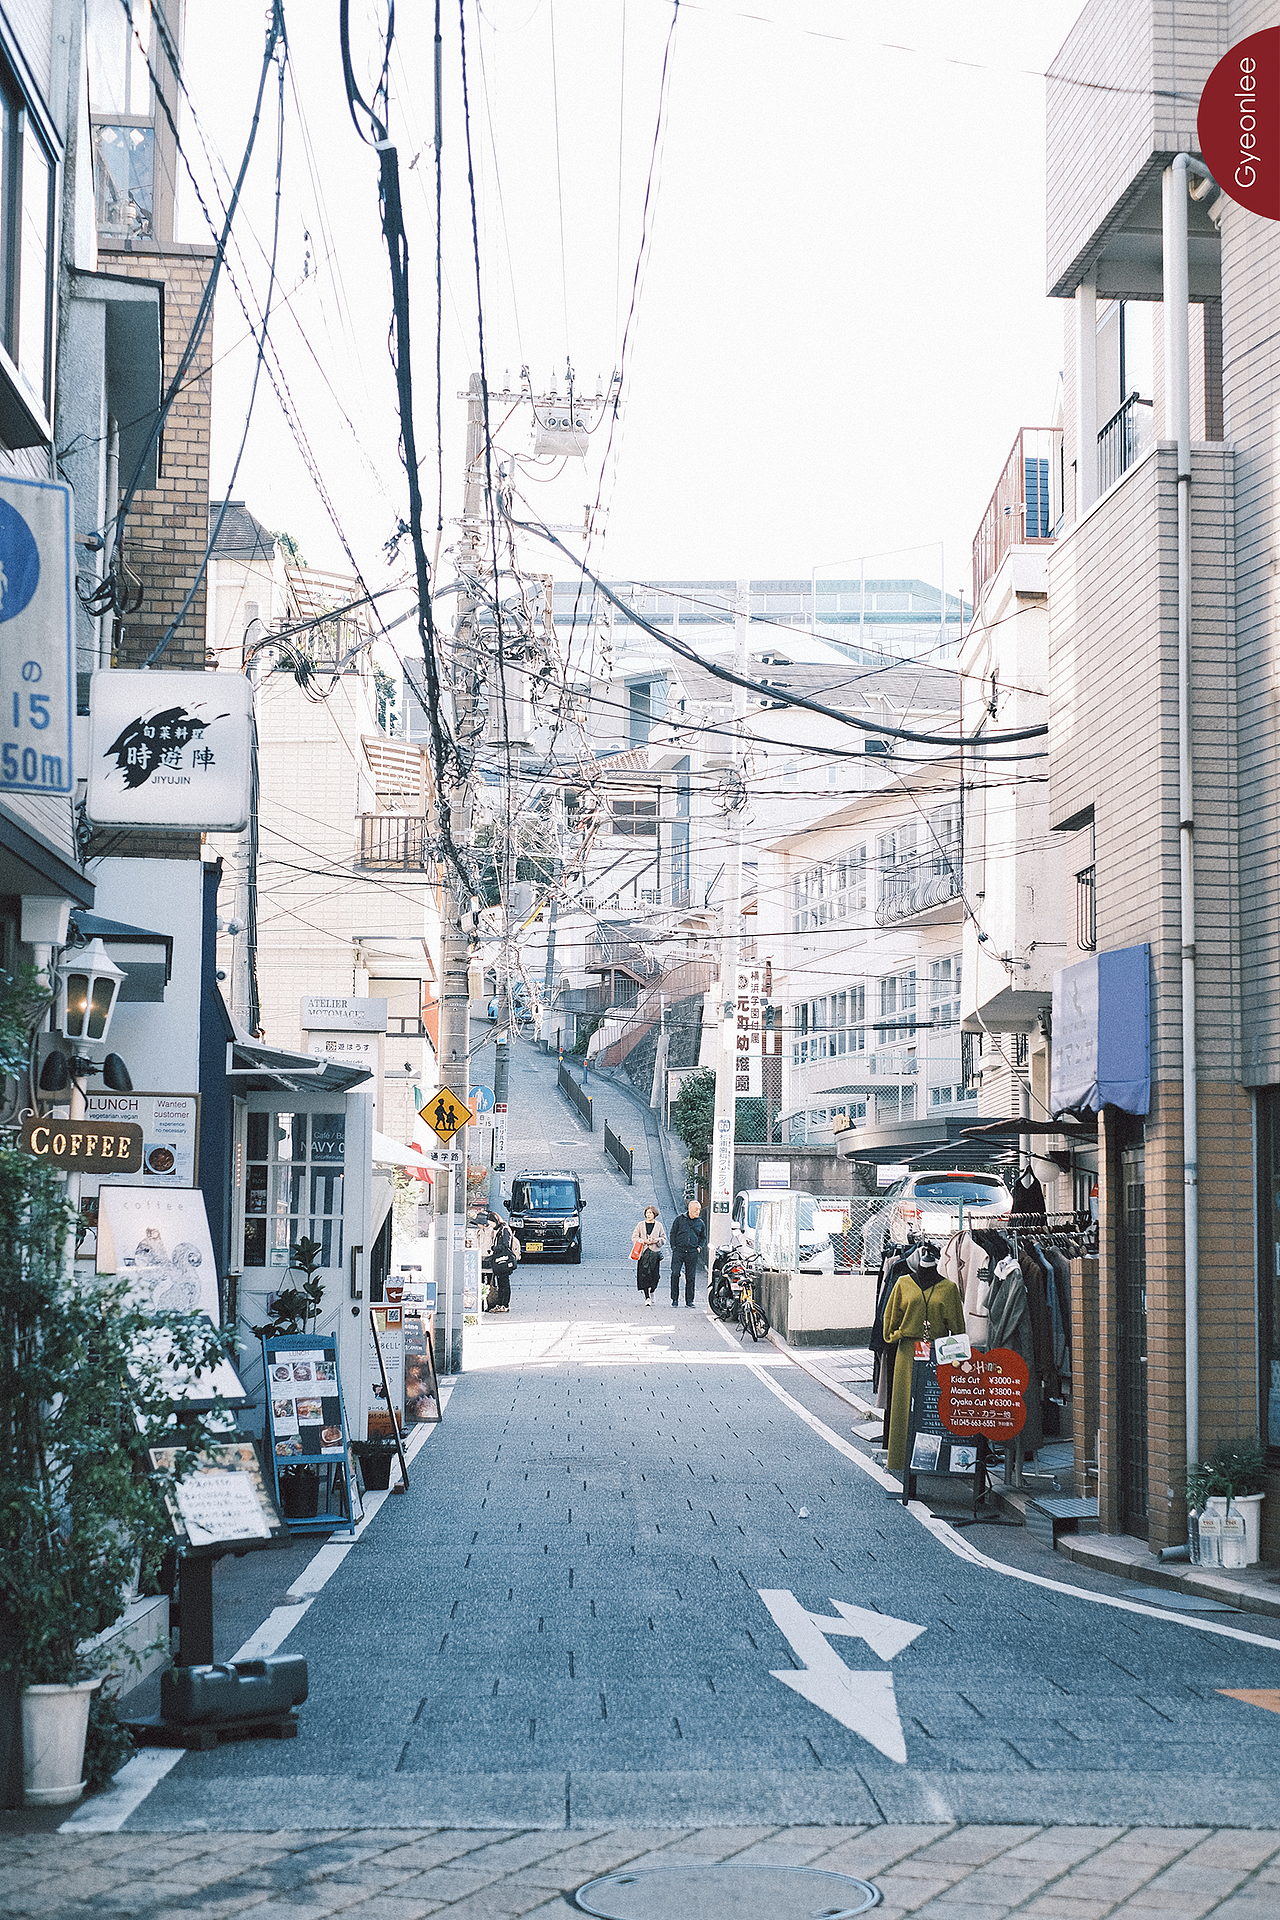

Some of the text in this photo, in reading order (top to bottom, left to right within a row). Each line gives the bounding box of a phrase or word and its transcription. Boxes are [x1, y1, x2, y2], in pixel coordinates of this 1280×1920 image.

[143, 725, 204, 740] 旬菜料理
[151, 776, 191, 785] JIYUJIN
[308, 999, 348, 1009] ATELIER
[89, 1098, 139, 1111] LUNCH
[157, 1100, 187, 1108] Wanted
[153, 1110, 190, 1119] customer
[30, 1126, 132, 1159] COFFEE
[301, 1141, 335, 1153] NAVY
[430, 1152, 459, 1161] 通学路
[123, 1201, 184, 1211] coffee
[950, 1375, 966, 1384] Kids
[967, 1376, 980, 1384] Cut
[950, 1386, 972, 1395] Mama
[973, 1387, 986, 1395] Cut
[950, 1397, 973, 1407] Oyako
[974, 1398, 987, 1407] Cut
